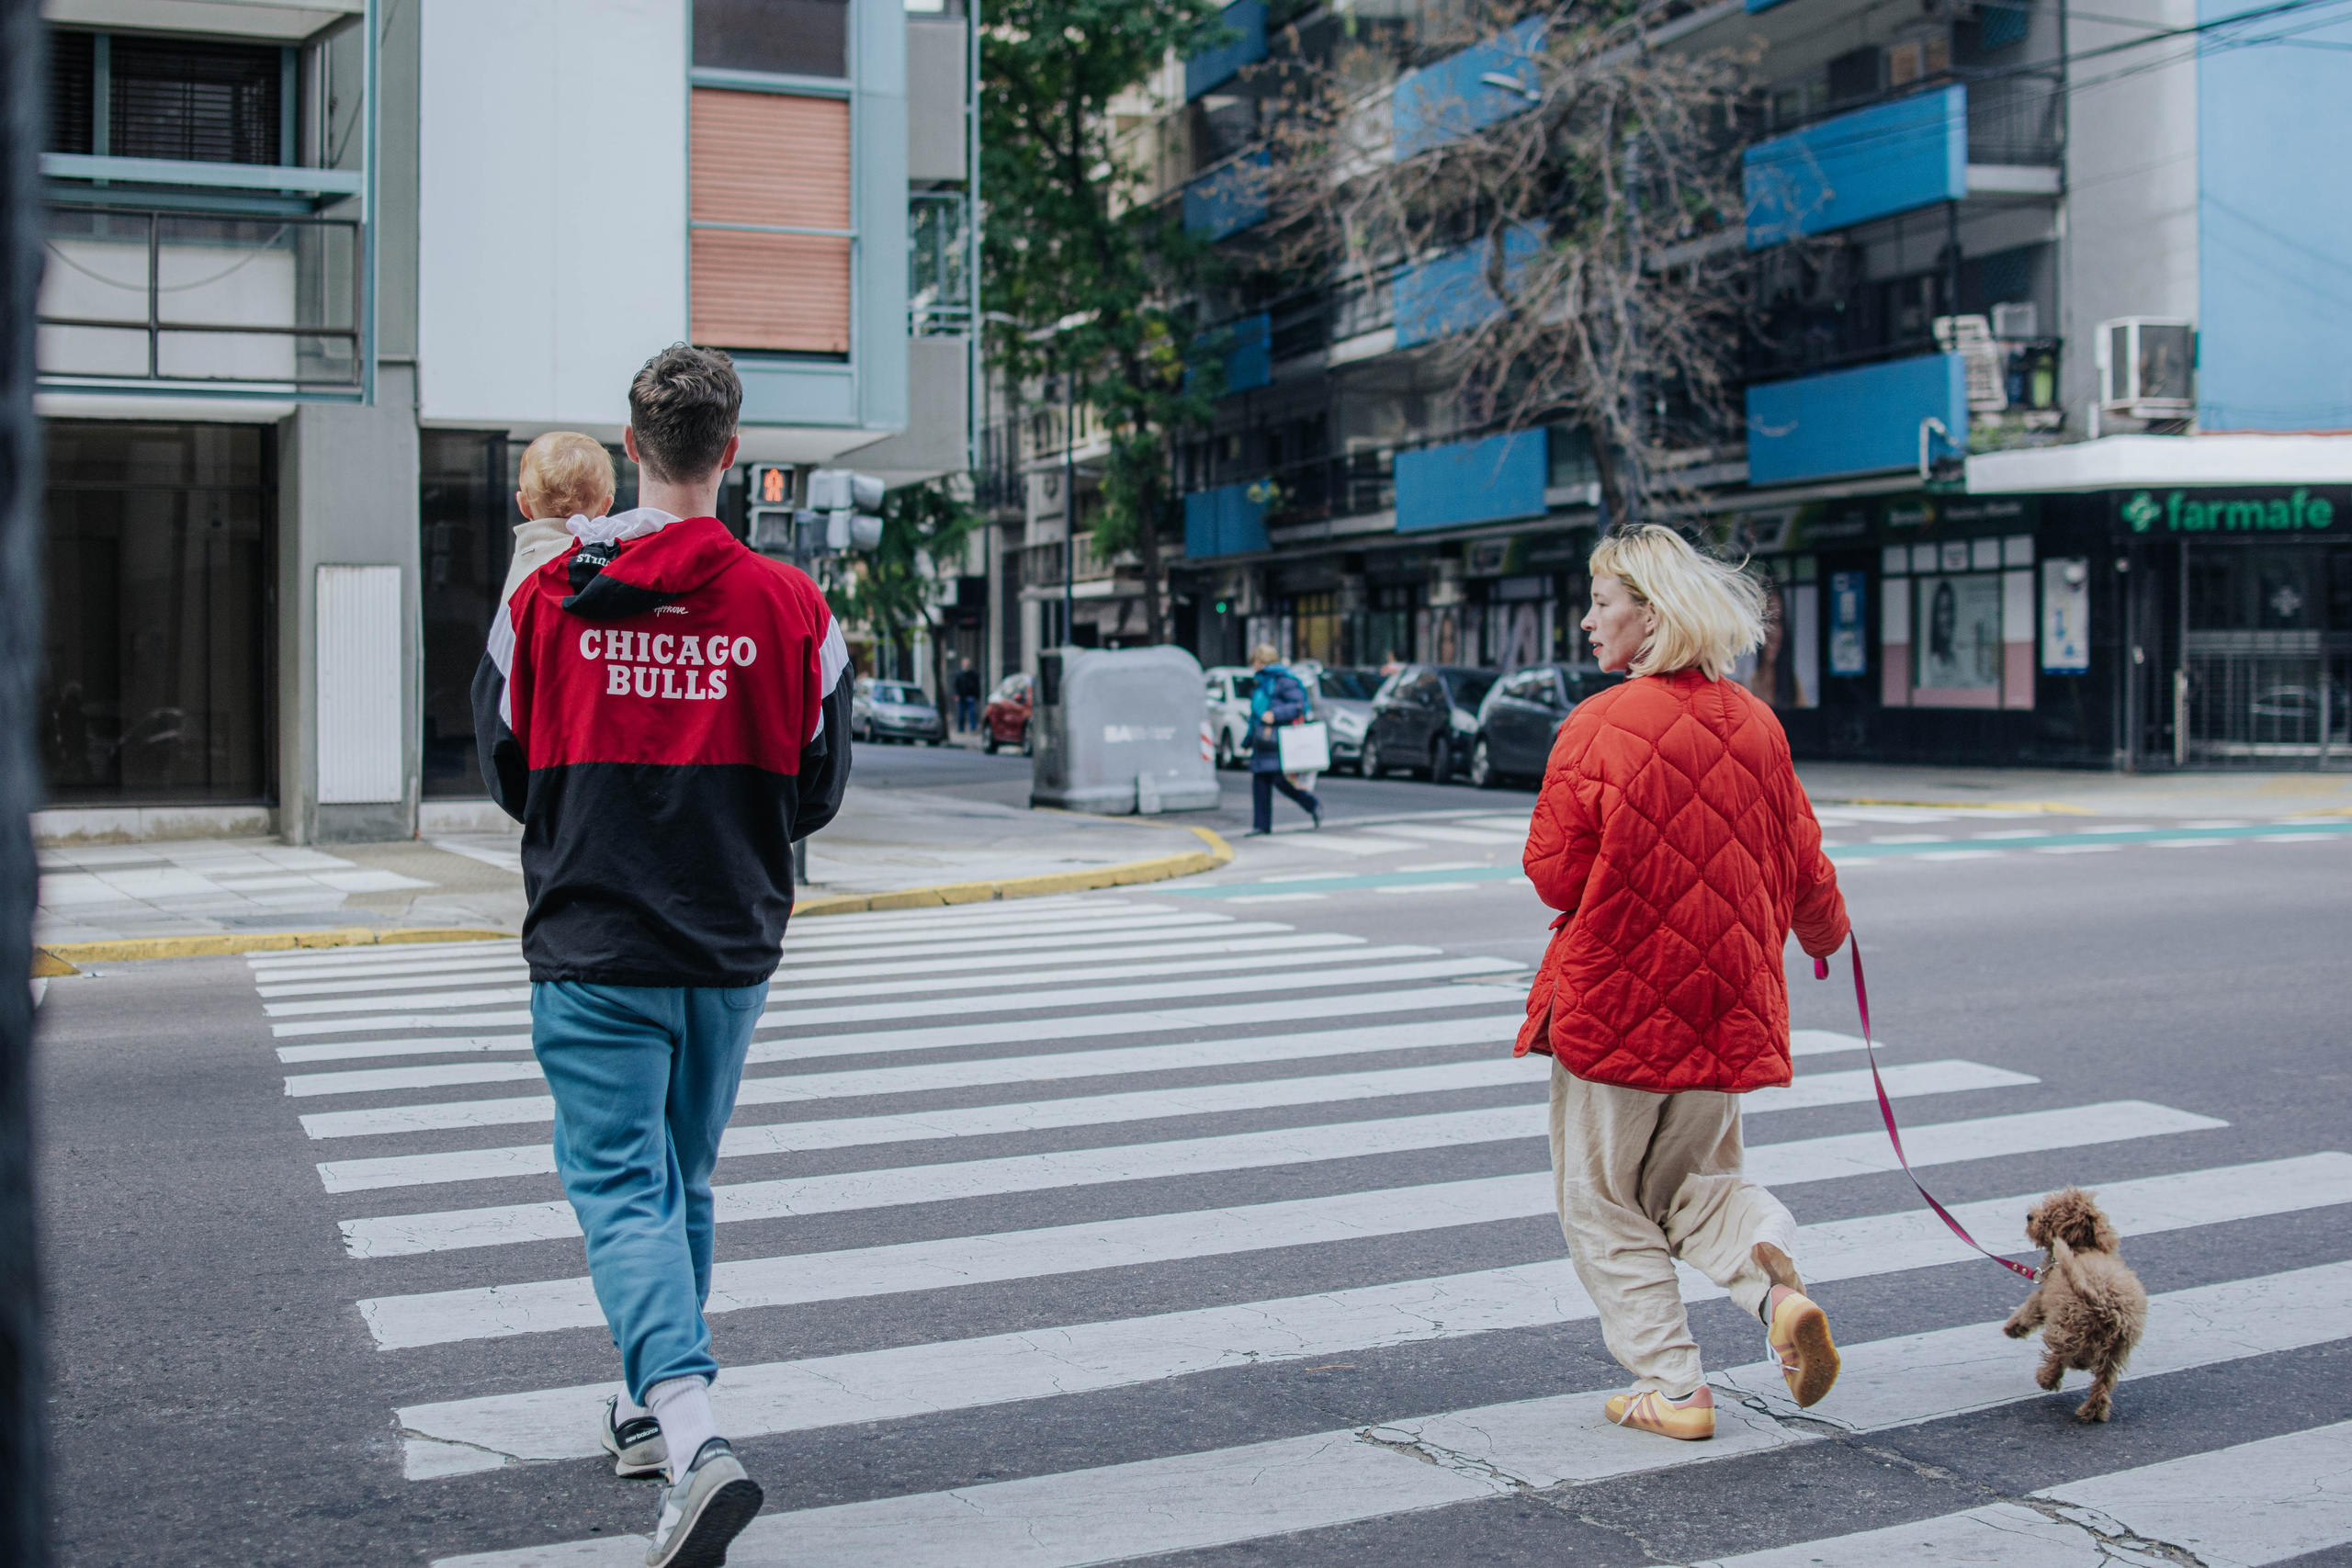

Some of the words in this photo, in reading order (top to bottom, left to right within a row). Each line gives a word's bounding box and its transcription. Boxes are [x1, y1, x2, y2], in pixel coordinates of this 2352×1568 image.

[2166, 487, 2335, 531] farmafe
[579, 628, 757, 667] CHICAGO
[606, 664, 728, 700] BULLS
[626, 1435, 637, 1443] new
[636, 1427, 659, 1439] balance
